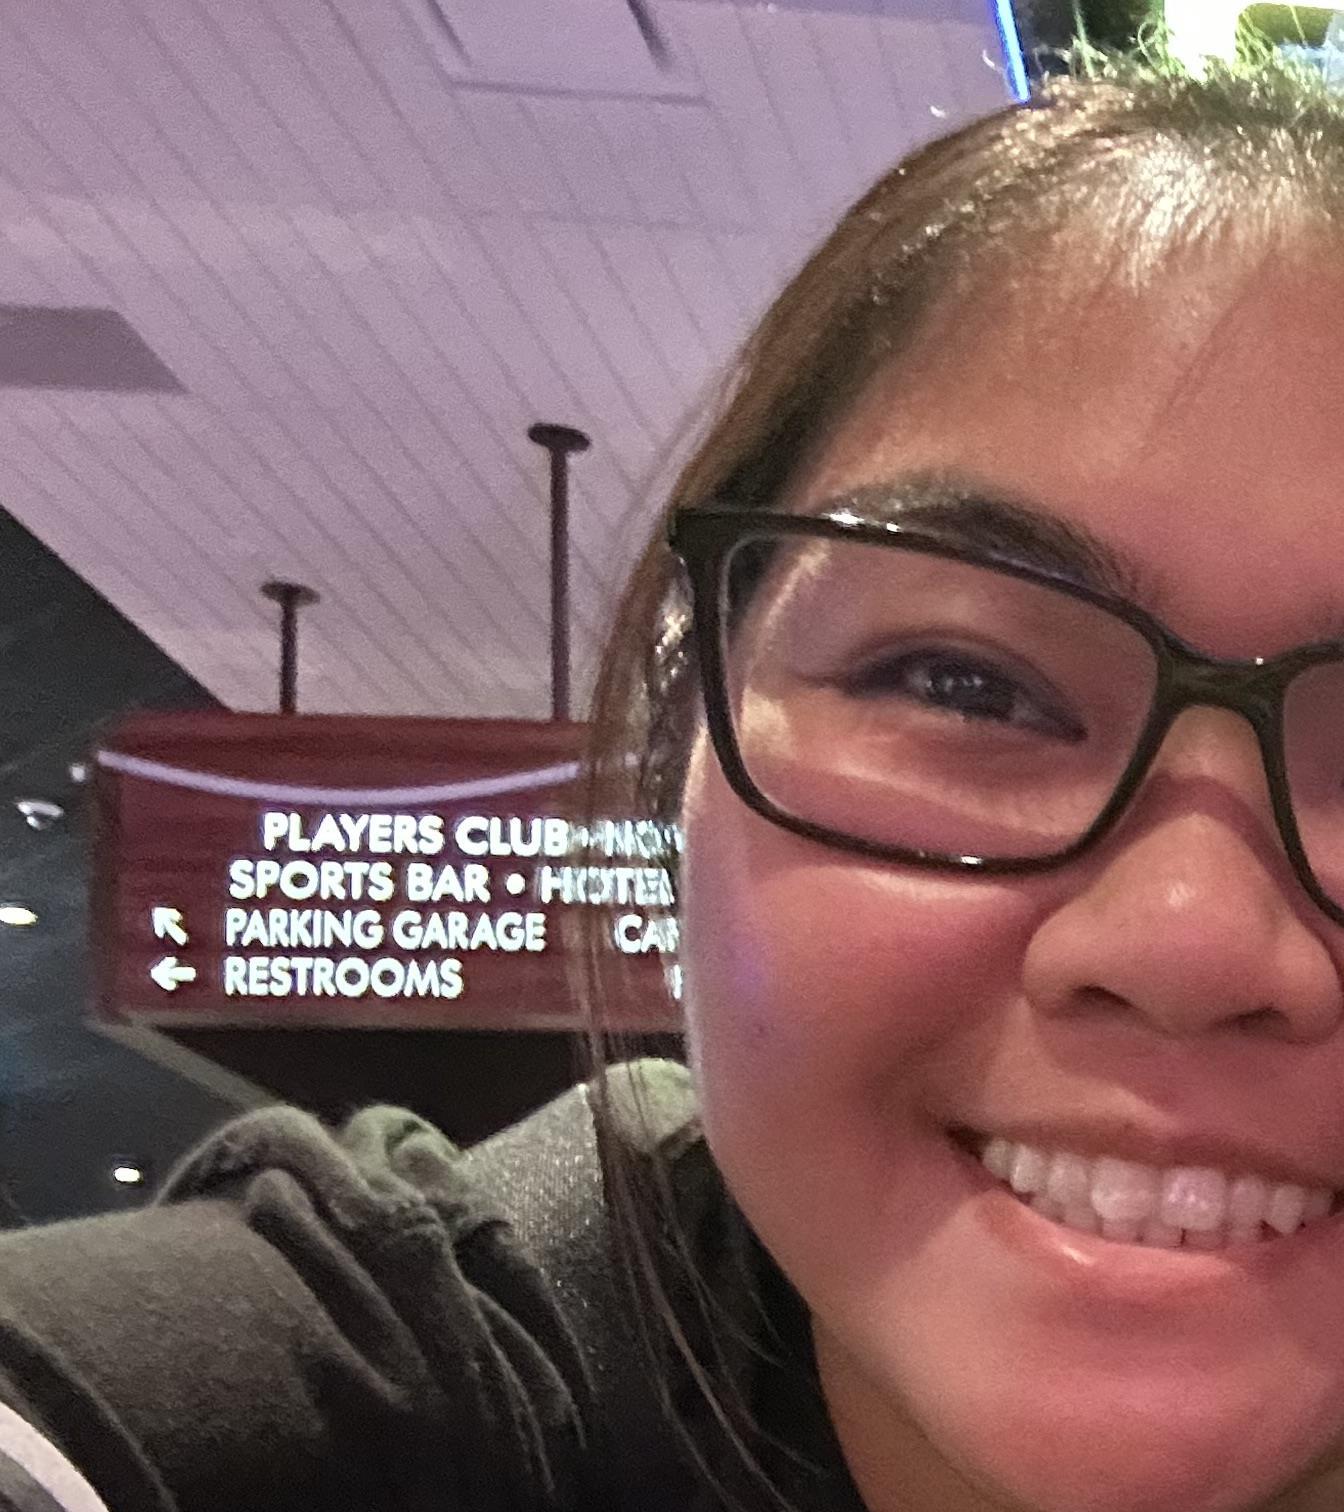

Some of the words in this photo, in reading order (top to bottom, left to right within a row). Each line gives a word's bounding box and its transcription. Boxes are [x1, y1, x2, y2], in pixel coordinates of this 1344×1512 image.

[263, 812, 445, 854] PLAYERS
[455, 815, 569, 857] CLUB
[229, 860, 395, 901] SPORTS
[407, 862, 491, 903] BAR
[226, 908, 385, 949] PARKING
[392, 910, 547, 951] GARAGE
[224, 956, 465, 998] RESTROOMS
